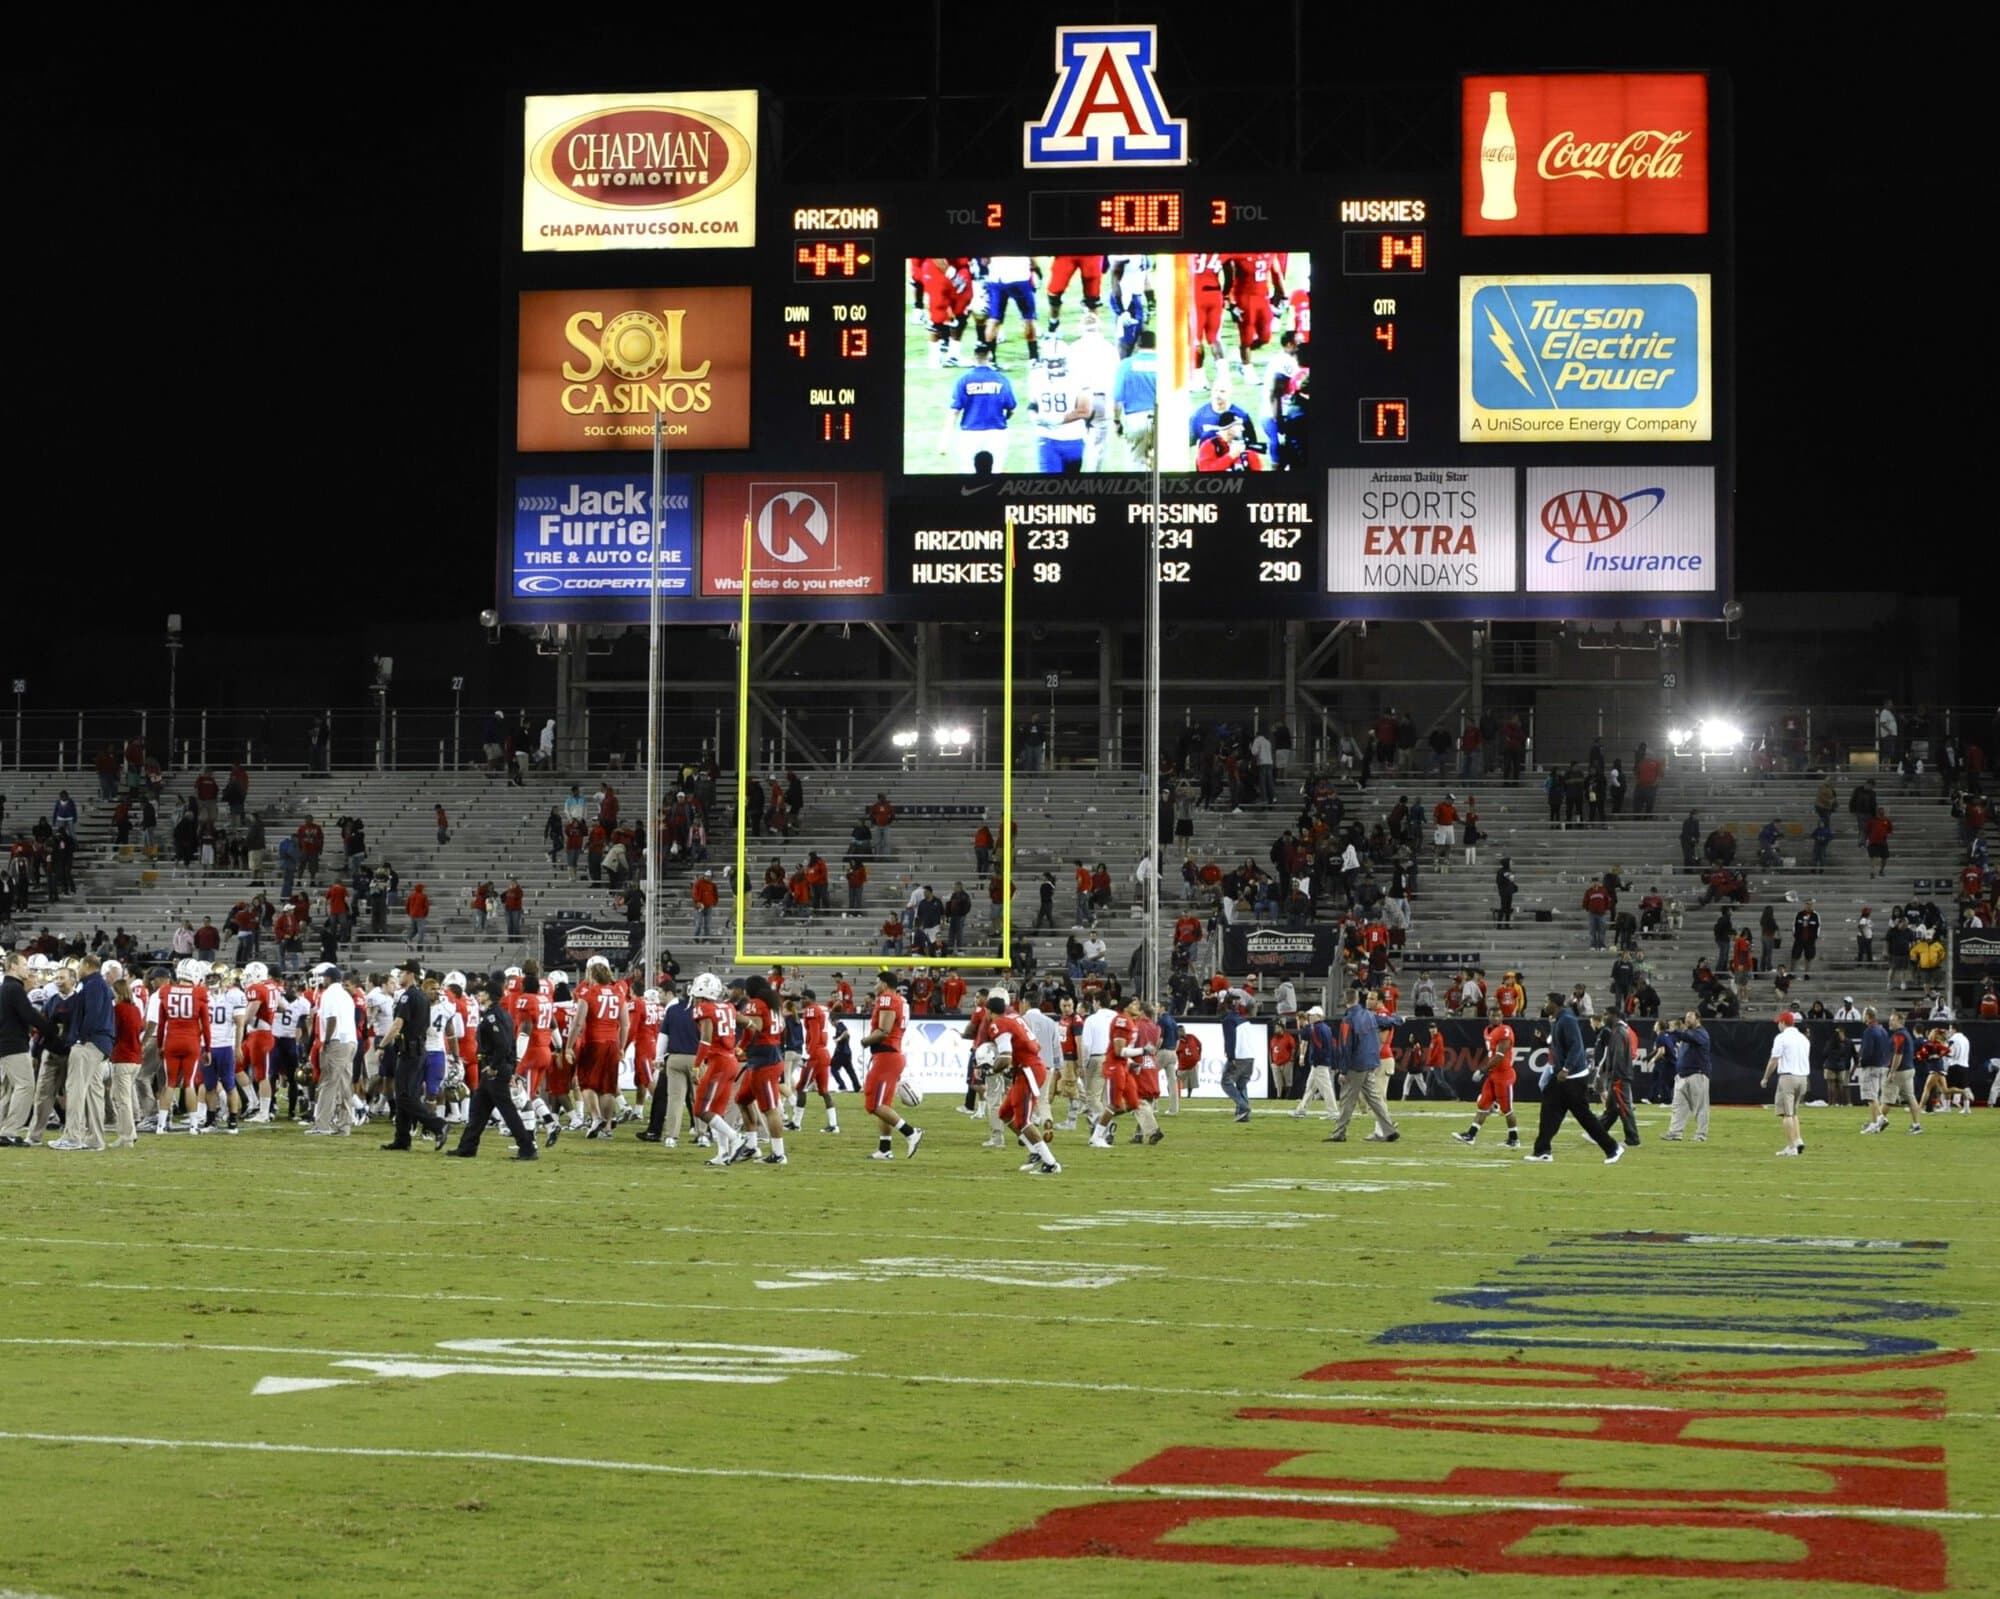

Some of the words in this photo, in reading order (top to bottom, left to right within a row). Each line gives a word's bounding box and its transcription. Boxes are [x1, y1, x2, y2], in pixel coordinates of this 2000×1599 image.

[568, 131, 712, 171] CHAPMAN
[1537, 130, 1692, 180] Coca-Cola
[572, 172, 709, 187] AUTOMOTIVE
[794, 208, 879, 230] ARIZONA
[946, 209, 982, 225] TOL
[986, 204, 1002, 227] 2
[1100, 195, 1179, 232] :00
[1211, 200, 1226, 224] 3
[1232, 205, 1268, 221] TOL
[1341, 201, 1425, 222] HUSKIES
[540, 221, 739, 237] CHAPMANTUCSON.COM
[798, 243, 856, 276] 44
[1381, 235, 1422, 268] 14
[785, 306, 809, 322] DWN
[833, 306, 847, 321] TO
[850, 305, 866, 321] GO
[1373, 299, 1396, 315] QTR
[1529, 300, 1645, 330] Tucson
[562, 309, 711, 383] SOL
[789, 330, 805, 357] 4
[842, 329, 867, 356] 13
[1376, 323, 1393, 350] 4
[1540, 332, 1676, 360] Electric
[1554, 362, 1676, 391] Power
[561, 383, 712, 415] CASINOS
[810, 389, 835, 405] BALL
[839, 388, 855, 404] ON
[584, 425, 687, 436] SOLCASINOSCOM
[825, 413, 850, 440] 11
[1471, 418, 1483, 431] A
[1487, 417, 1565, 431] UniSource
[1569, 417, 1621, 434] Energy
[1625, 417, 1697, 434] Company
[1370, 472, 1412, 483] Arizona
[1414, 471, 1443, 484] Daily
[1445, 471, 1469, 482] Star
[560, 484, 647, 516] Jack
[1362, 490, 1477, 519] SPORTS
[1005, 504, 1096, 524] RUSHING
[1128, 503, 1218, 524] PASSING
[1246, 503, 1313, 524] TOTAL
[1552, 491, 1618, 542] AAA
[539, 514, 666, 546] Furrier
[914, 530, 1003, 551] ARIZONA
[1027, 530, 1069, 550] 233
[1259, 529, 1301, 549] 467
[1364, 524, 1477, 556] EXTRA
[524, 551, 563, 564] TIRE
[567, 550, 580, 564] &
[585, 550, 632, 564] AUTO
[1585, 551, 1702, 571] Insurance
[714, 578, 746, 590] Wha
[752, 578, 779, 589] else
[782, 578, 800, 589] do
[802, 579, 827, 591] you
[829, 576, 871, 588] need?
[912, 563, 1003, 584] HUSKIES
[1033, 562, 1061, 583] 98
[1259, 562, 1301, 582] 290
[1364, 563, 1478, 587] MONDAYS
[452, 679, 464, 692] 27
[1046, 676, 1059, 690] 28
[1663, 676, 1675, 690] 29
[1288, 937, 1313, 945] FAMILY
[167, 994, 193, 1019] 50
[282, 1009, 293, 1026] 6
[597, 995, 619, 1019] 75
[432, 1014, 443, 1032] 4
[990, 1022, 999, 1034] 3
[330, 1338, 857, 1384] 10
